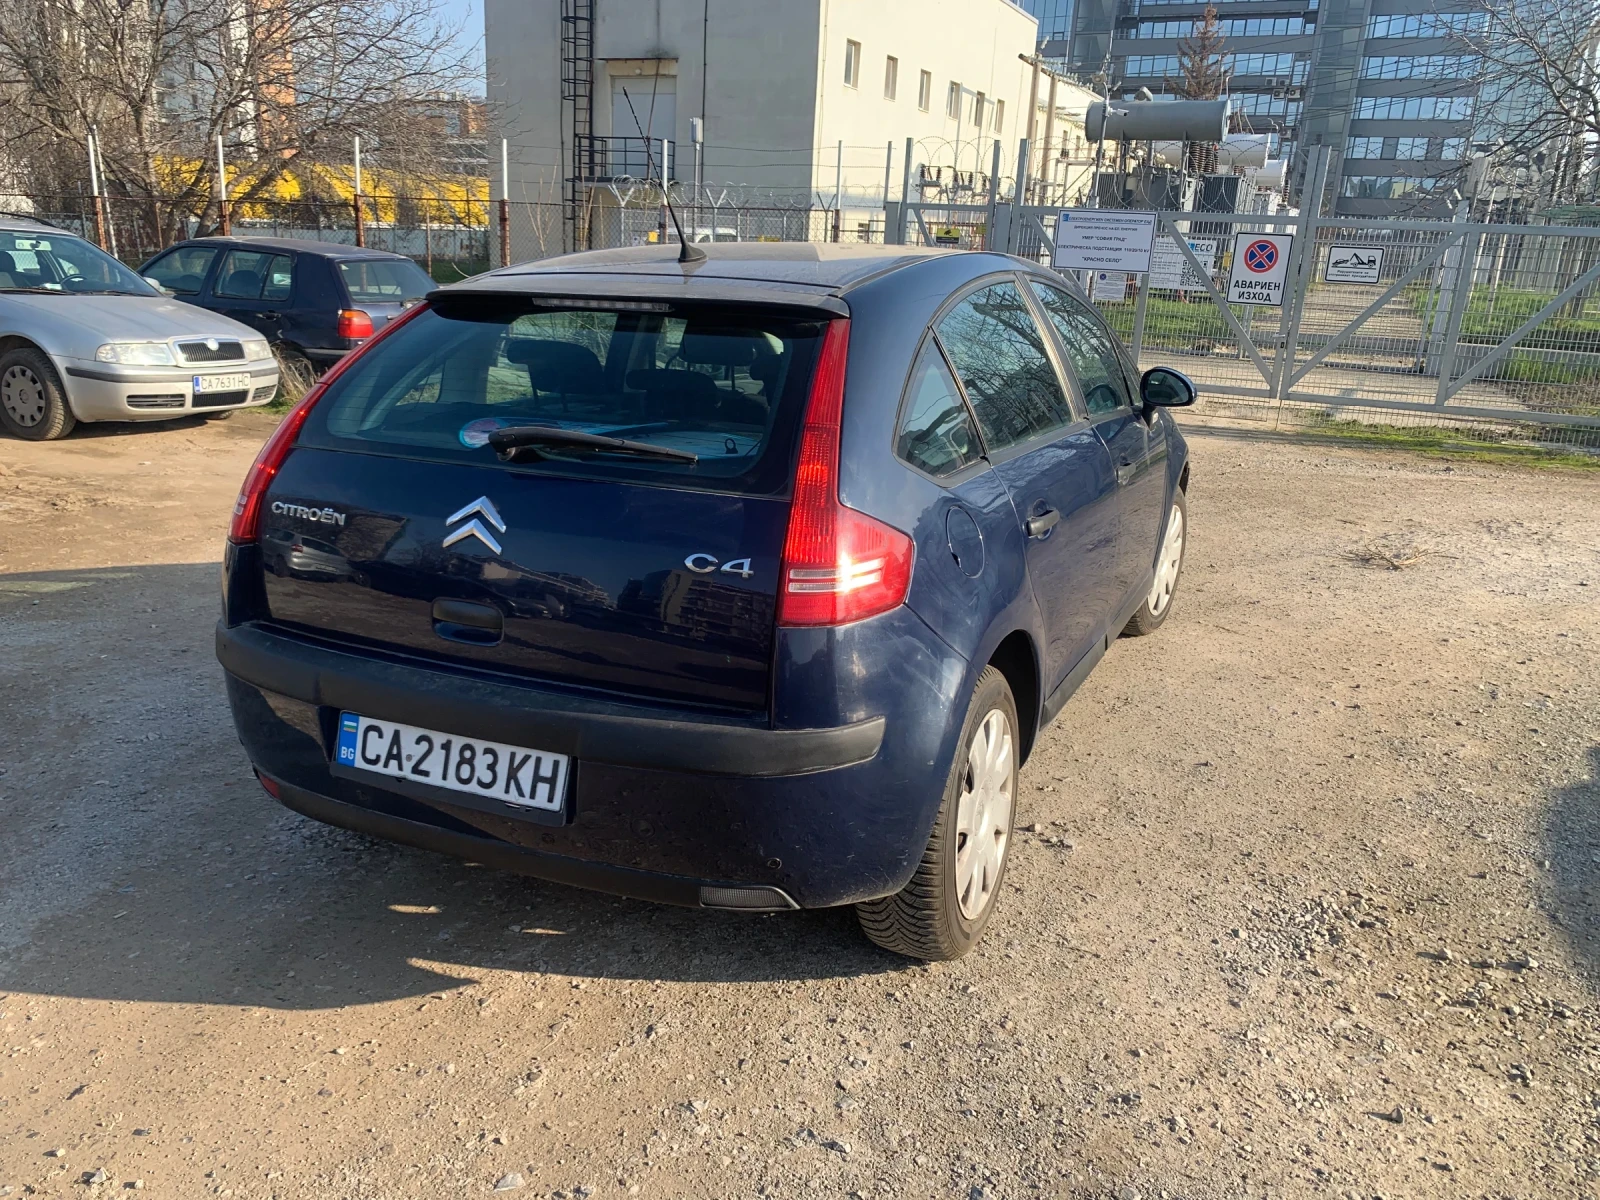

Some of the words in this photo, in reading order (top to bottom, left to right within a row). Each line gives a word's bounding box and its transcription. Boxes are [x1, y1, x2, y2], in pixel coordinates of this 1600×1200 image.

[1233, 280, 1281, 291] АВАРИЕН
[1238, 291, 1272, 302] ИЗХОД
[271, 501, 346, 526] CITROËN
[684, 553, 754, 578] C4
[340, 746, 354, 760] BG
